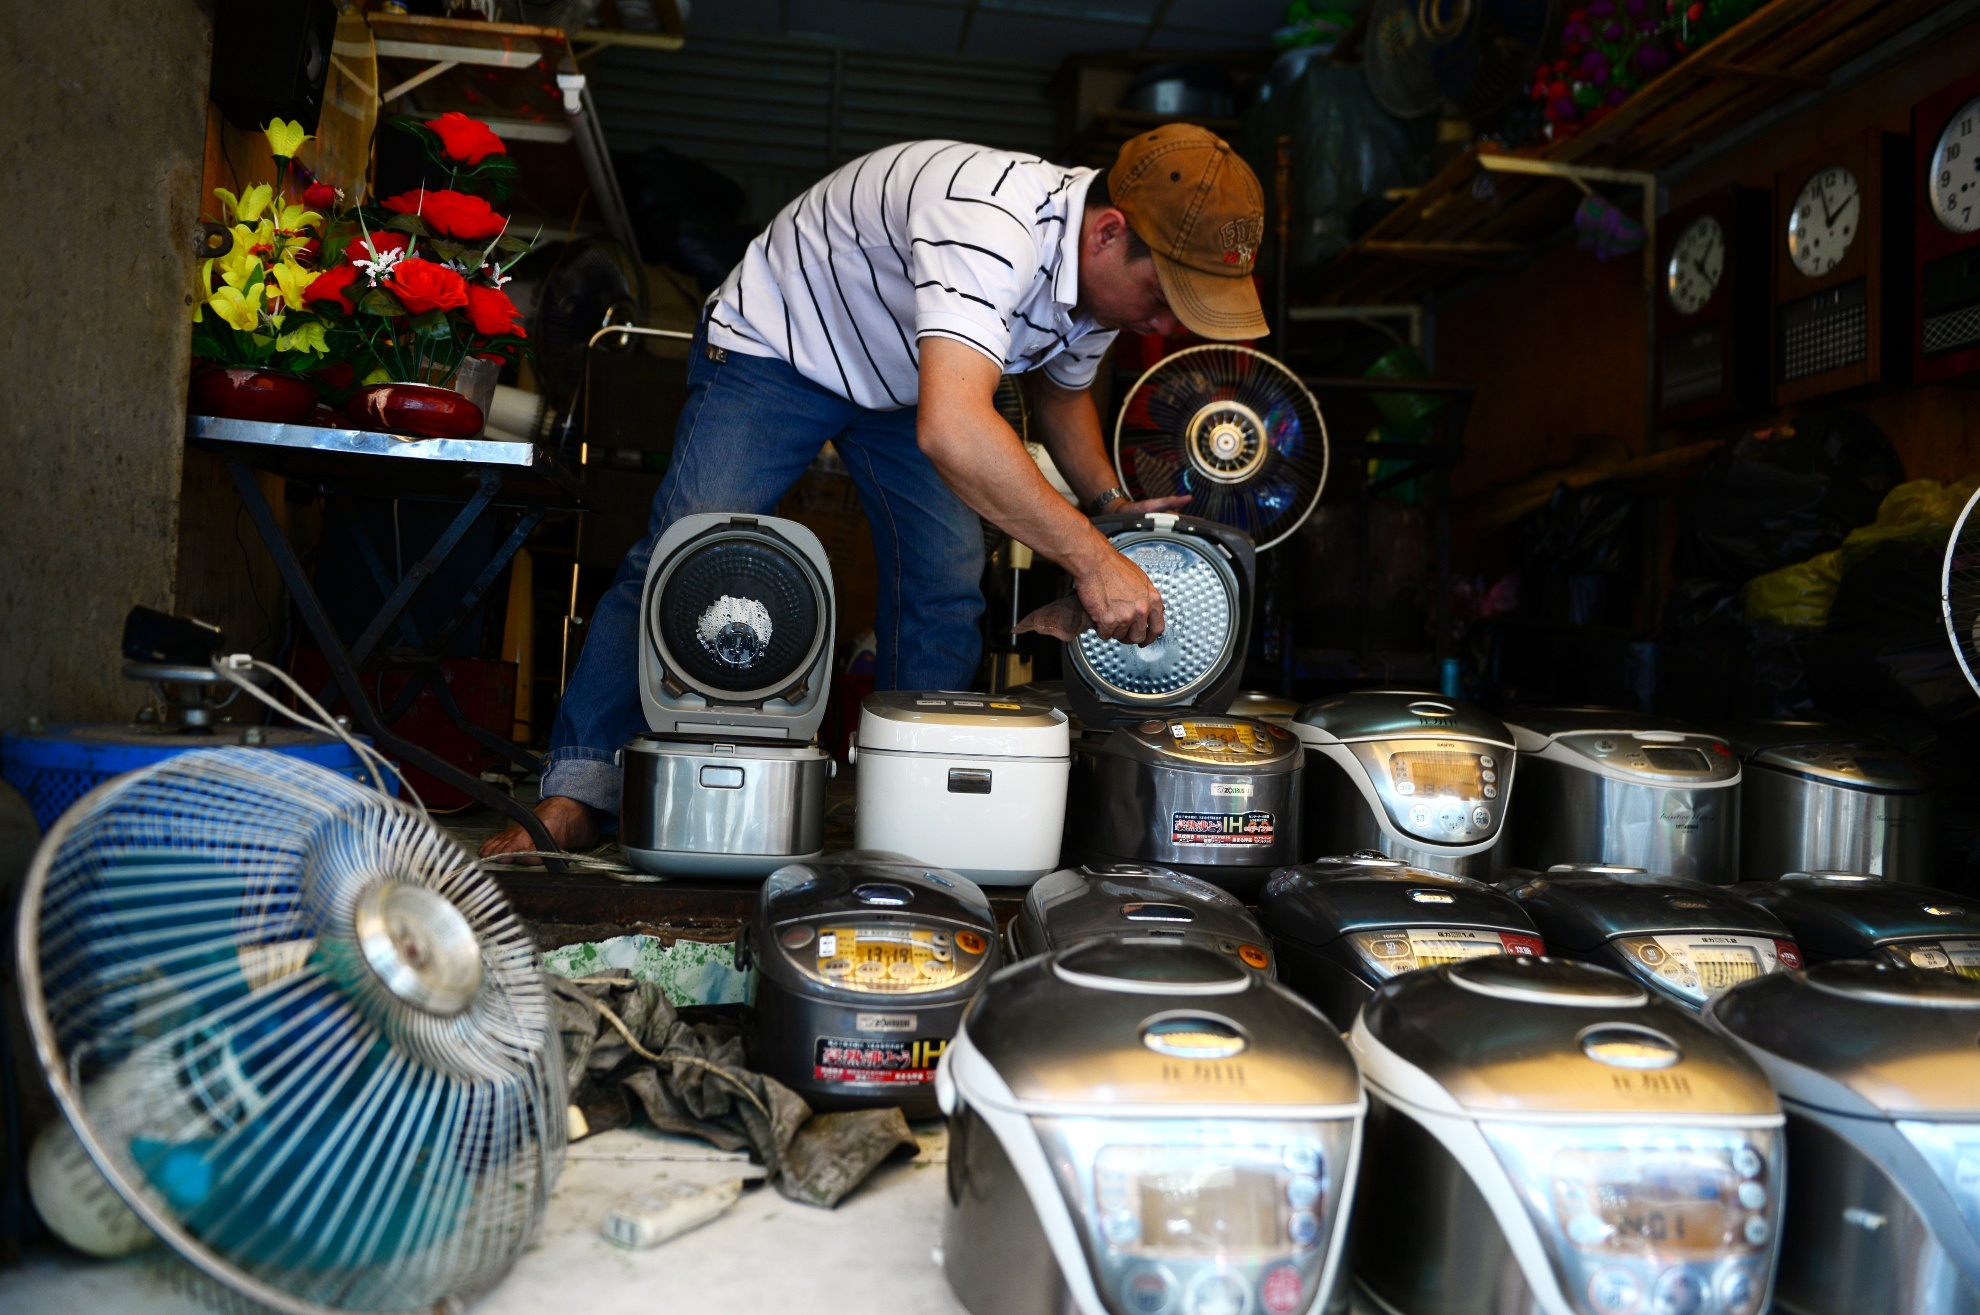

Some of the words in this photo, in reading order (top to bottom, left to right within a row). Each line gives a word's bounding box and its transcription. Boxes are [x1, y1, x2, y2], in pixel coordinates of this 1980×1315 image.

[1961, 118, 1973, 137] 11
[1945, 142, 1961, 163] 10
[1825, 172, 1837, 189] 12
[1941, 170, 1951, 188] 9
[1947, 192, 1957, 212] 8
[1800, 205, 1812, 221] 10
[1962, 205, 1973, 224] 7
[1812, 256, 1821, 273] 7
[1222, 816, 1243, 833] IH
[1416, 813, 1425, 823] 切
[911, 1040, 946, 1069] IH
